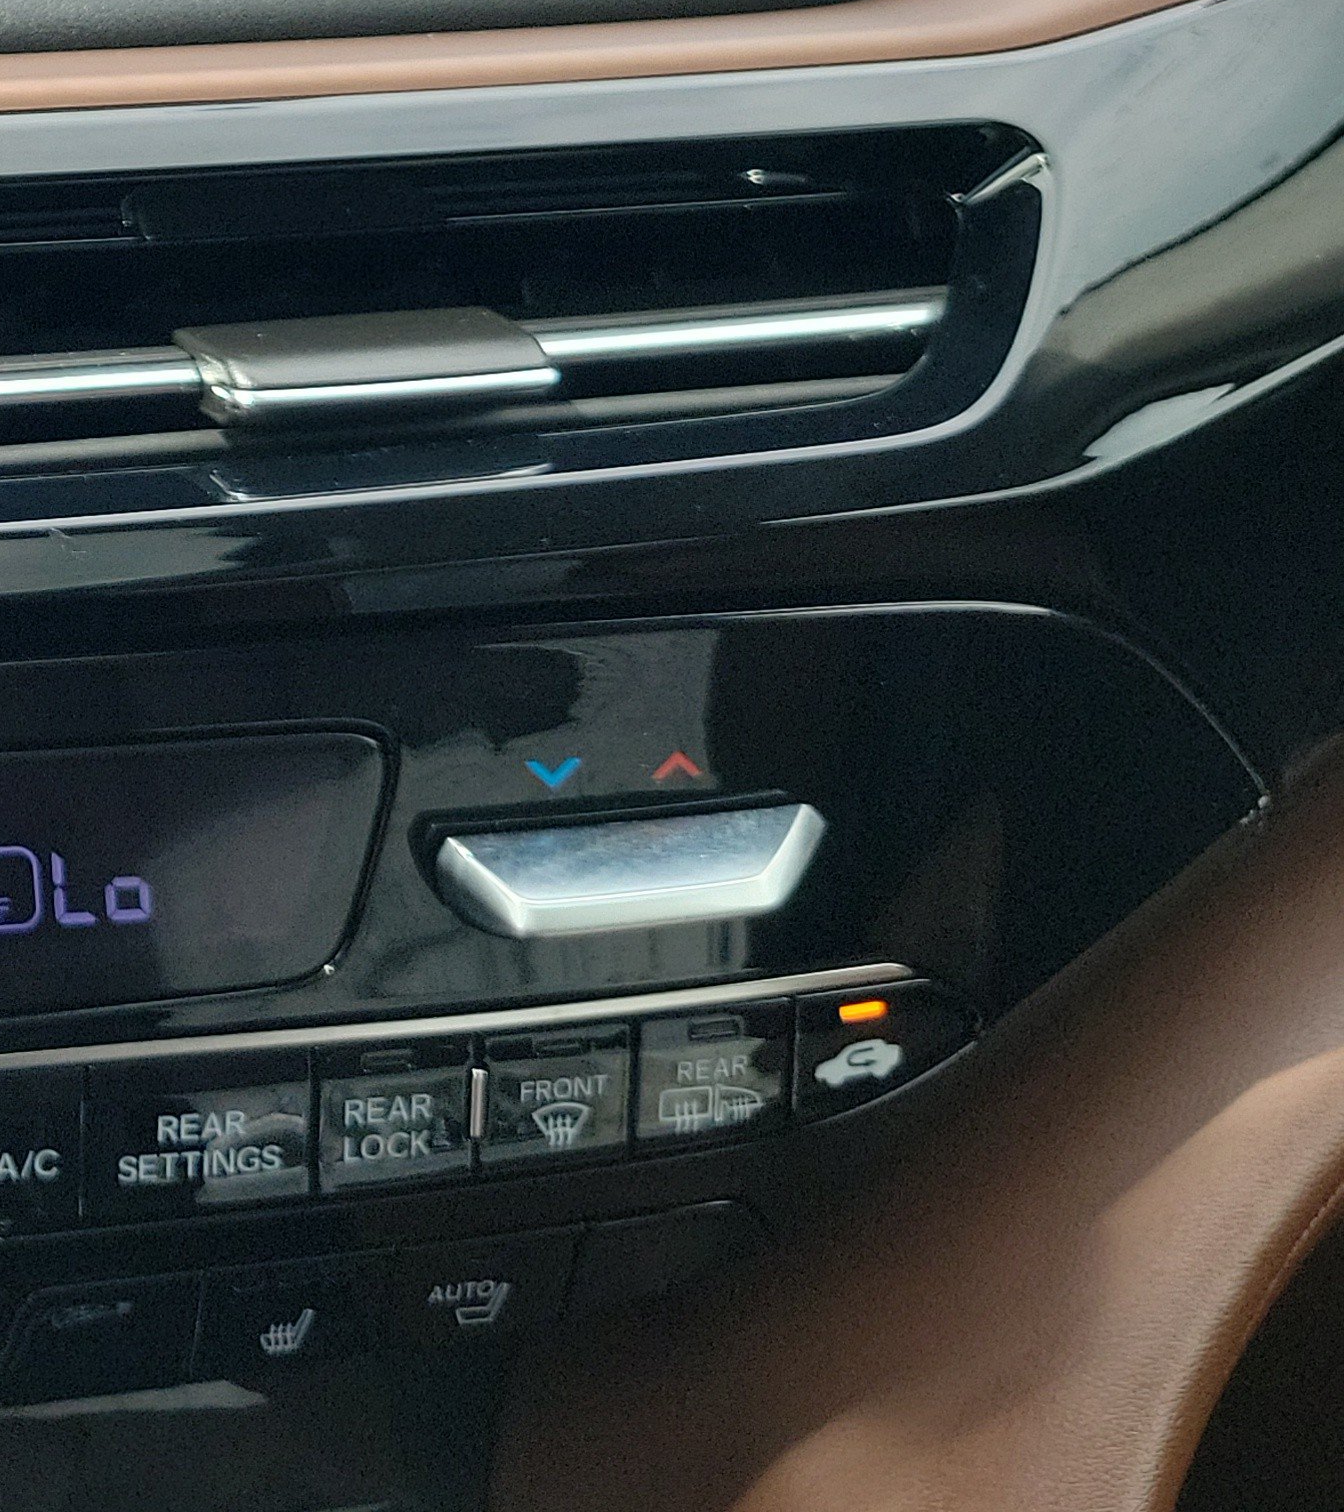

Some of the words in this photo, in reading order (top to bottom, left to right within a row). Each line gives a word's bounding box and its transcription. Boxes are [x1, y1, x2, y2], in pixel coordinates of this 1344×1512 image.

[51, 852, 152, 925] Lo
[677, 1054, 749, 1081] REAR
[520, 1075, 608, 1103] FRONT
[344, 1094, 433, 1126] REAR
[157, 1110, 246, 1144] REAR
[343, 1129, 431, 1163] LOCK
[118, 1145, 283, 1184] SETTINGS
[429, 1280, 494, 1304] AUTO
